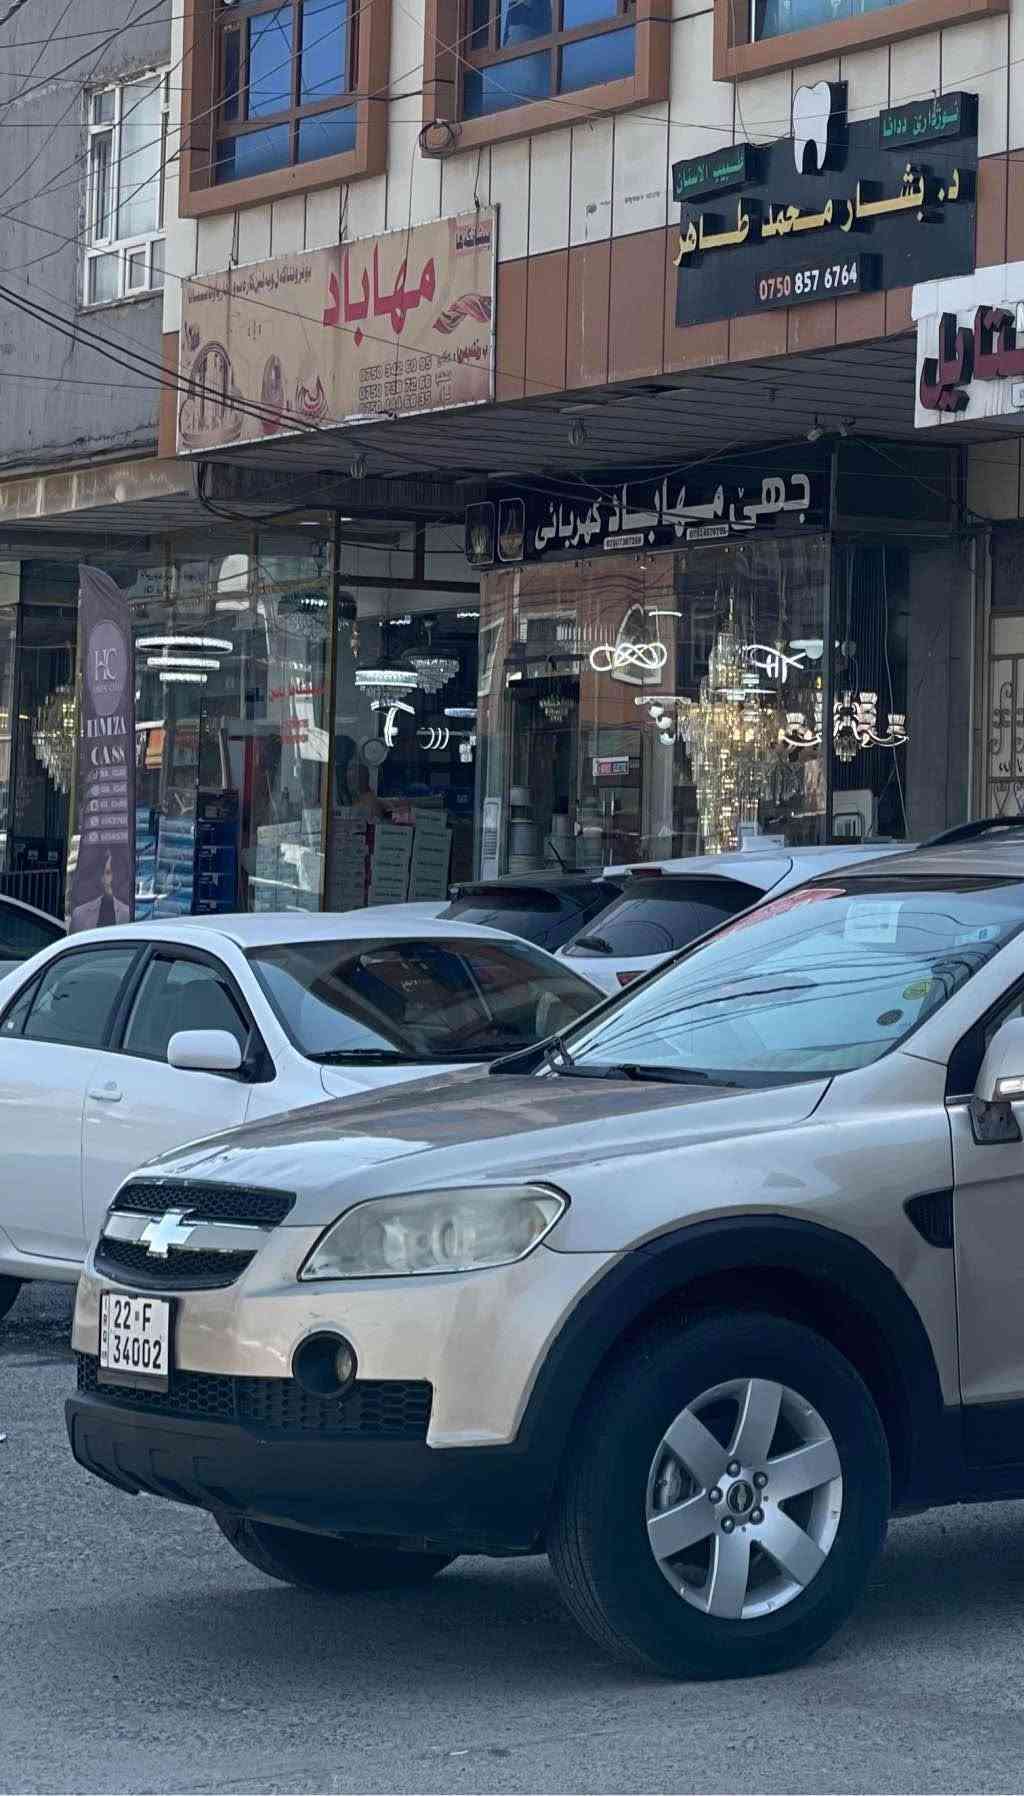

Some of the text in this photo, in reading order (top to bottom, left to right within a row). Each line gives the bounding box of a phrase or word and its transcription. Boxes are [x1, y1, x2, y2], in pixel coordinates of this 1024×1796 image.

[322, 240, 437, 347] مهاباد
[758, 261, 858, 301] 0750 857 6764
[114, 1299, 152, 1332] 22 F
[113, 1334, 162, 1370] 34002
